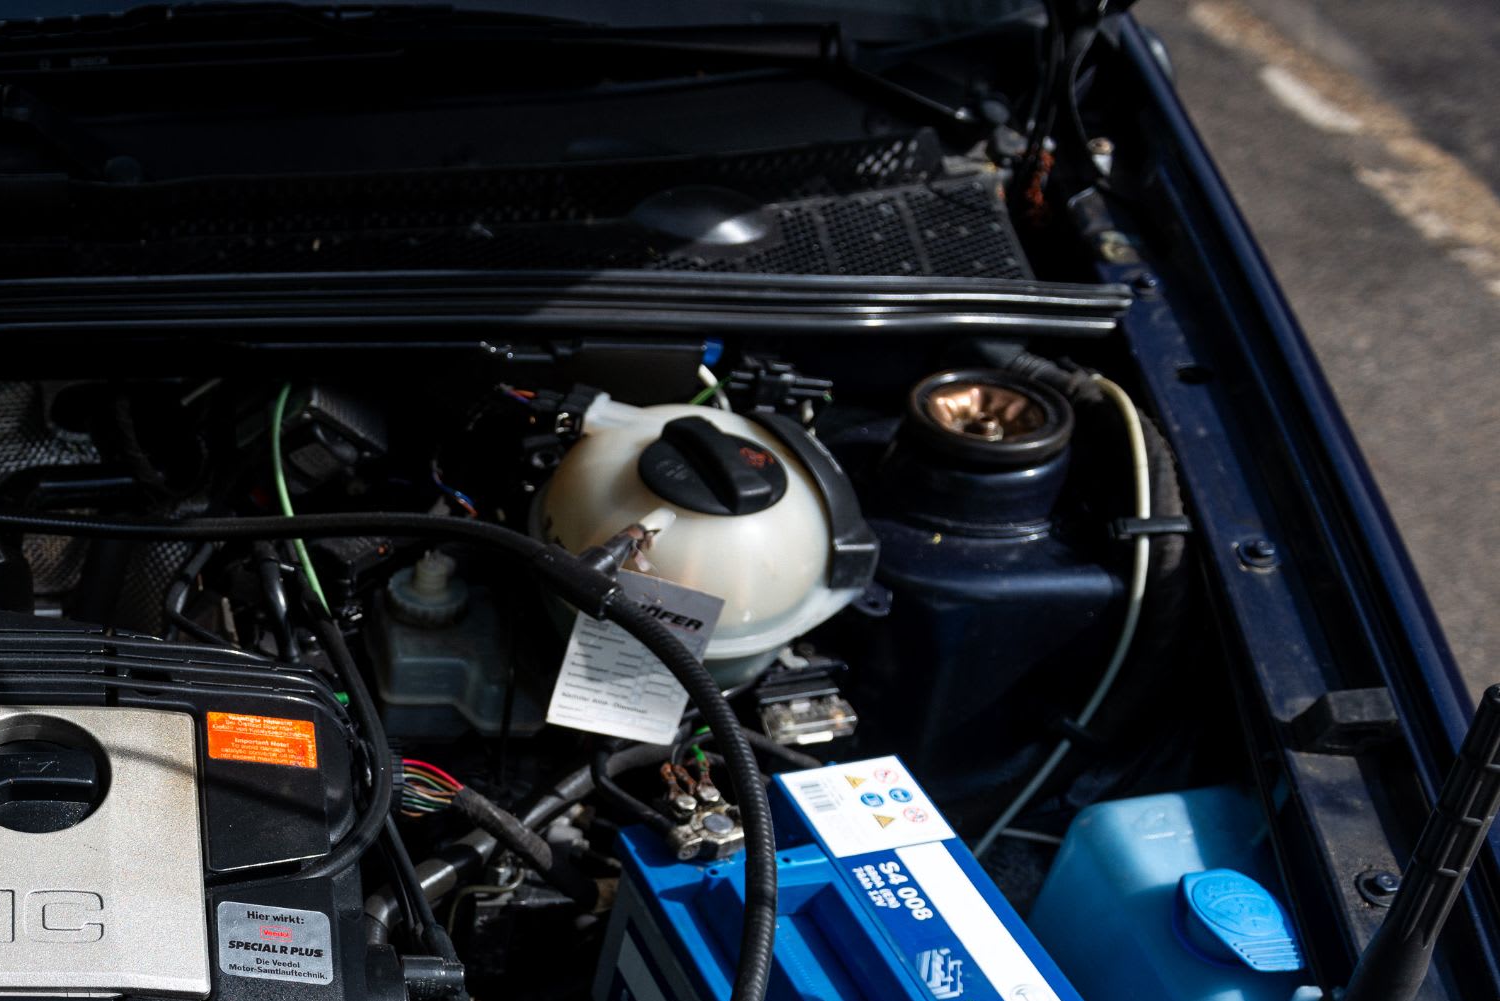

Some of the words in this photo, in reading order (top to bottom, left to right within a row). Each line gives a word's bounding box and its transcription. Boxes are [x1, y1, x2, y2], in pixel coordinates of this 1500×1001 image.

[879, 861, 909, 885] S4
[897, 886, 934, 921] 008
[247, 910, 268, 922] Hier
[270, 912, 304, 924] wirkt:
[228, 940, 278, 955] SPECIAL
[278, 944, 288, 955] R
[290, 946, 324, 958] PLUS
[228, 963, 328, 980] Motor-Samtlauftechnik.
[256, 958, 268, 966] Die
[271, 959, 300, 968] Veedol
